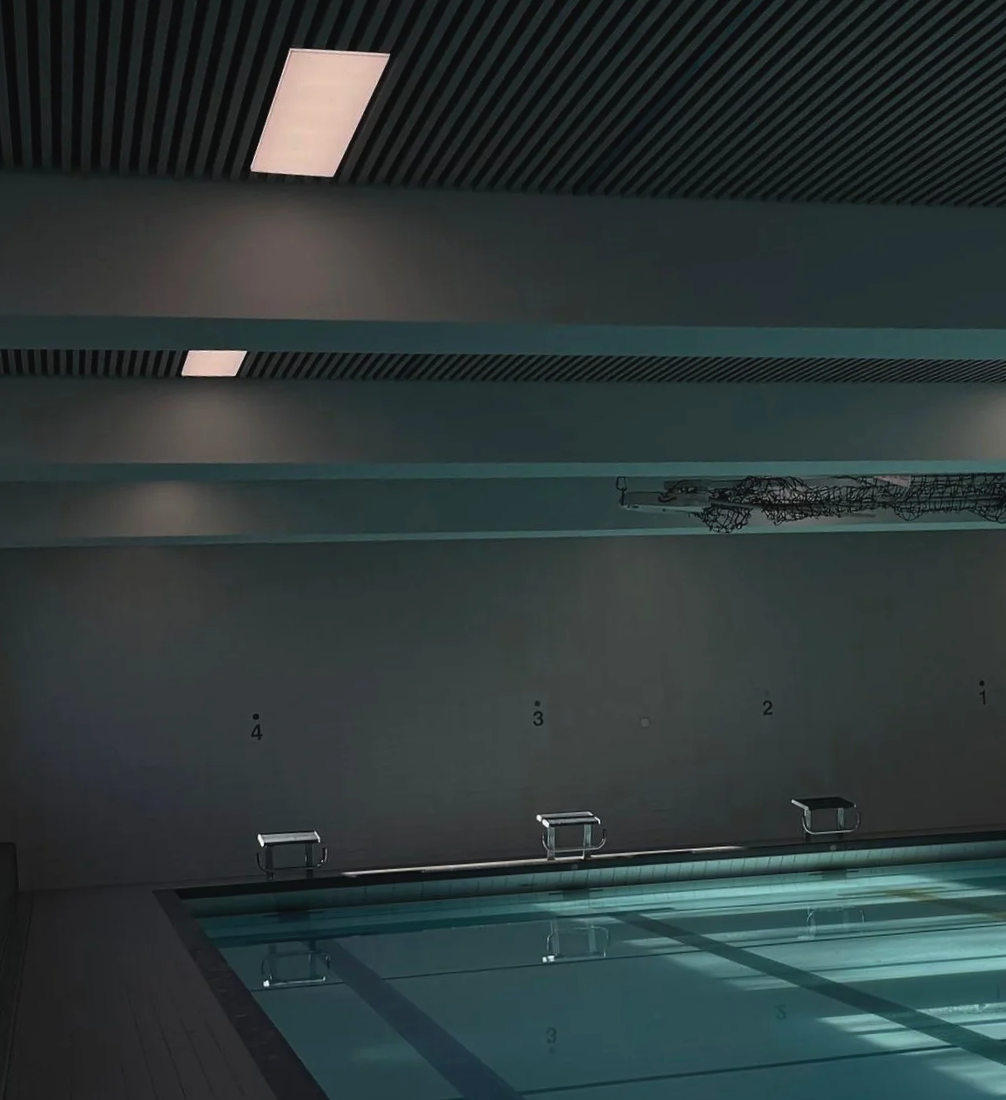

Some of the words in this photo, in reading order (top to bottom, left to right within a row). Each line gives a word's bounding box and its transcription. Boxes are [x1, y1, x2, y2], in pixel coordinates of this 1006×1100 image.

[979, 690, 986, 705] 1
[763, 700, 773, 716] 2
[532, 711, 544, 727] 3
[251, 724, 264, 741] 4
